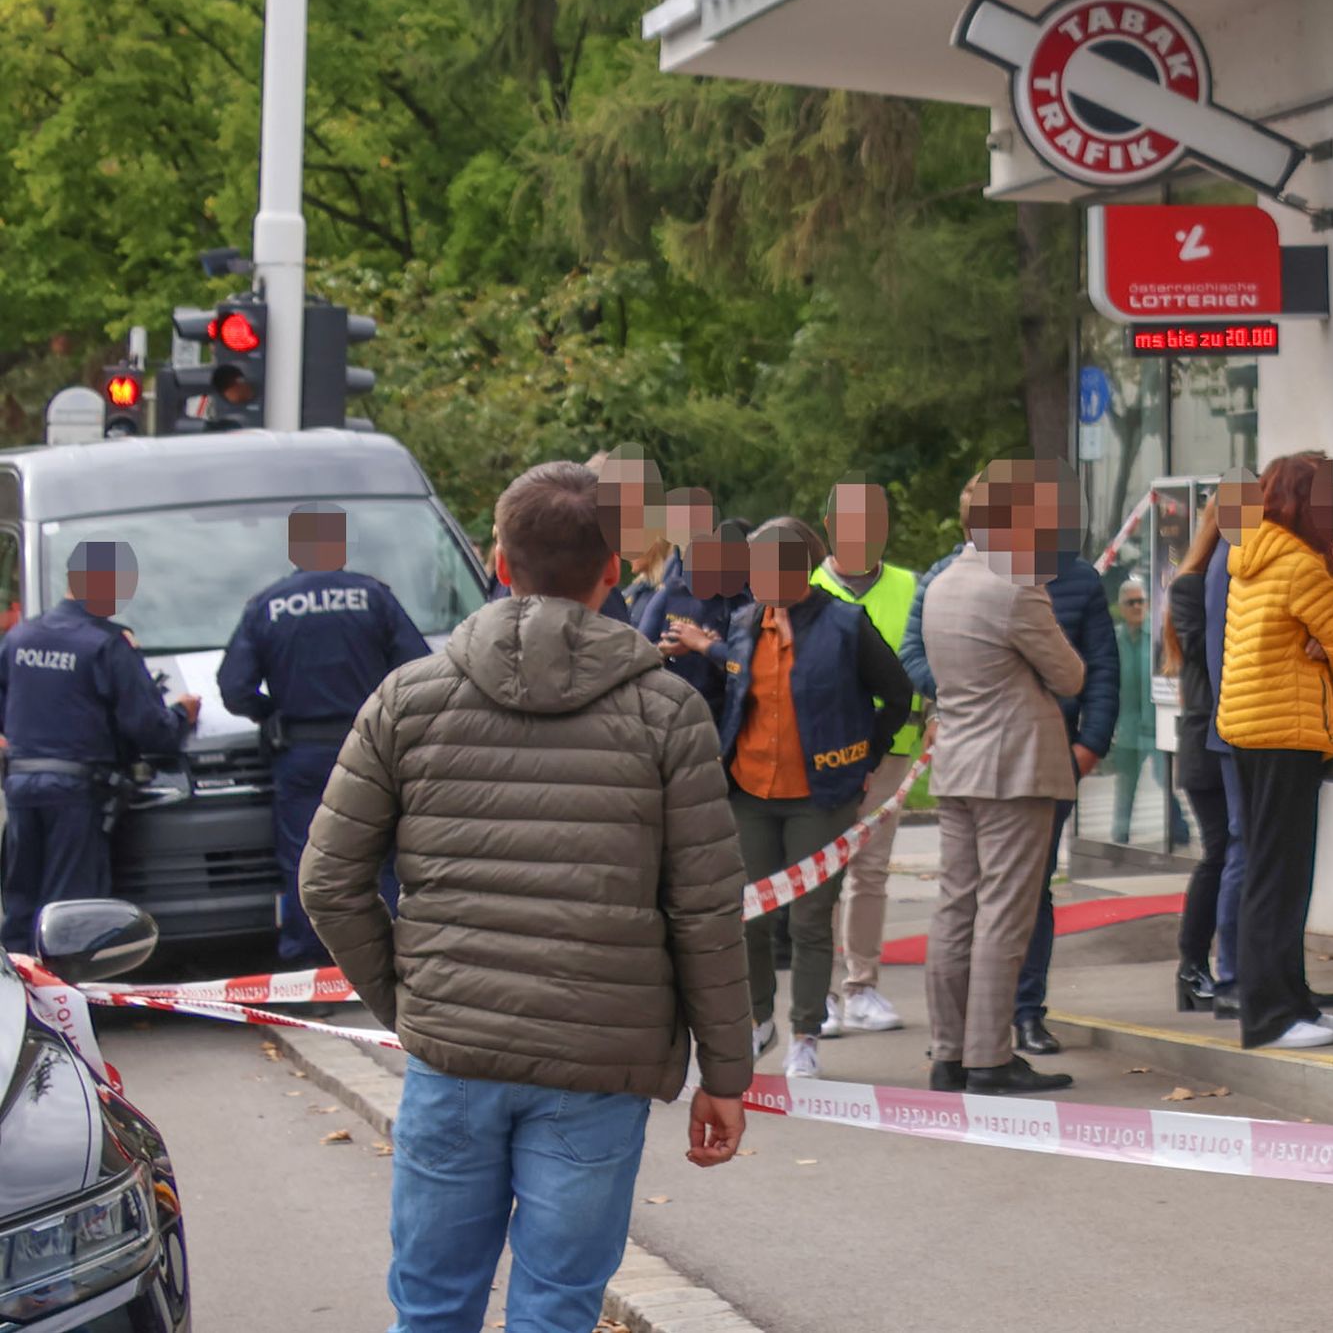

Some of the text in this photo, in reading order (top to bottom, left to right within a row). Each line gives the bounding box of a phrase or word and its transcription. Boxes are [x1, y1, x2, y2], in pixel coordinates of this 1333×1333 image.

[1057, 5, 1194, 81] TABAK
[1032, 71, 1159, 170] TRAFIK
[1128, 294, 1258, 308] LOTTERIEN
[1167, 328, 1198, 349] bis
[1199, 332, 1224, 348] zu
[1225, 326, 1277, 348] 20.00
[268, 588, 369, 623] POLIZEI
[15, 647, 77, 672] POLIZEI
